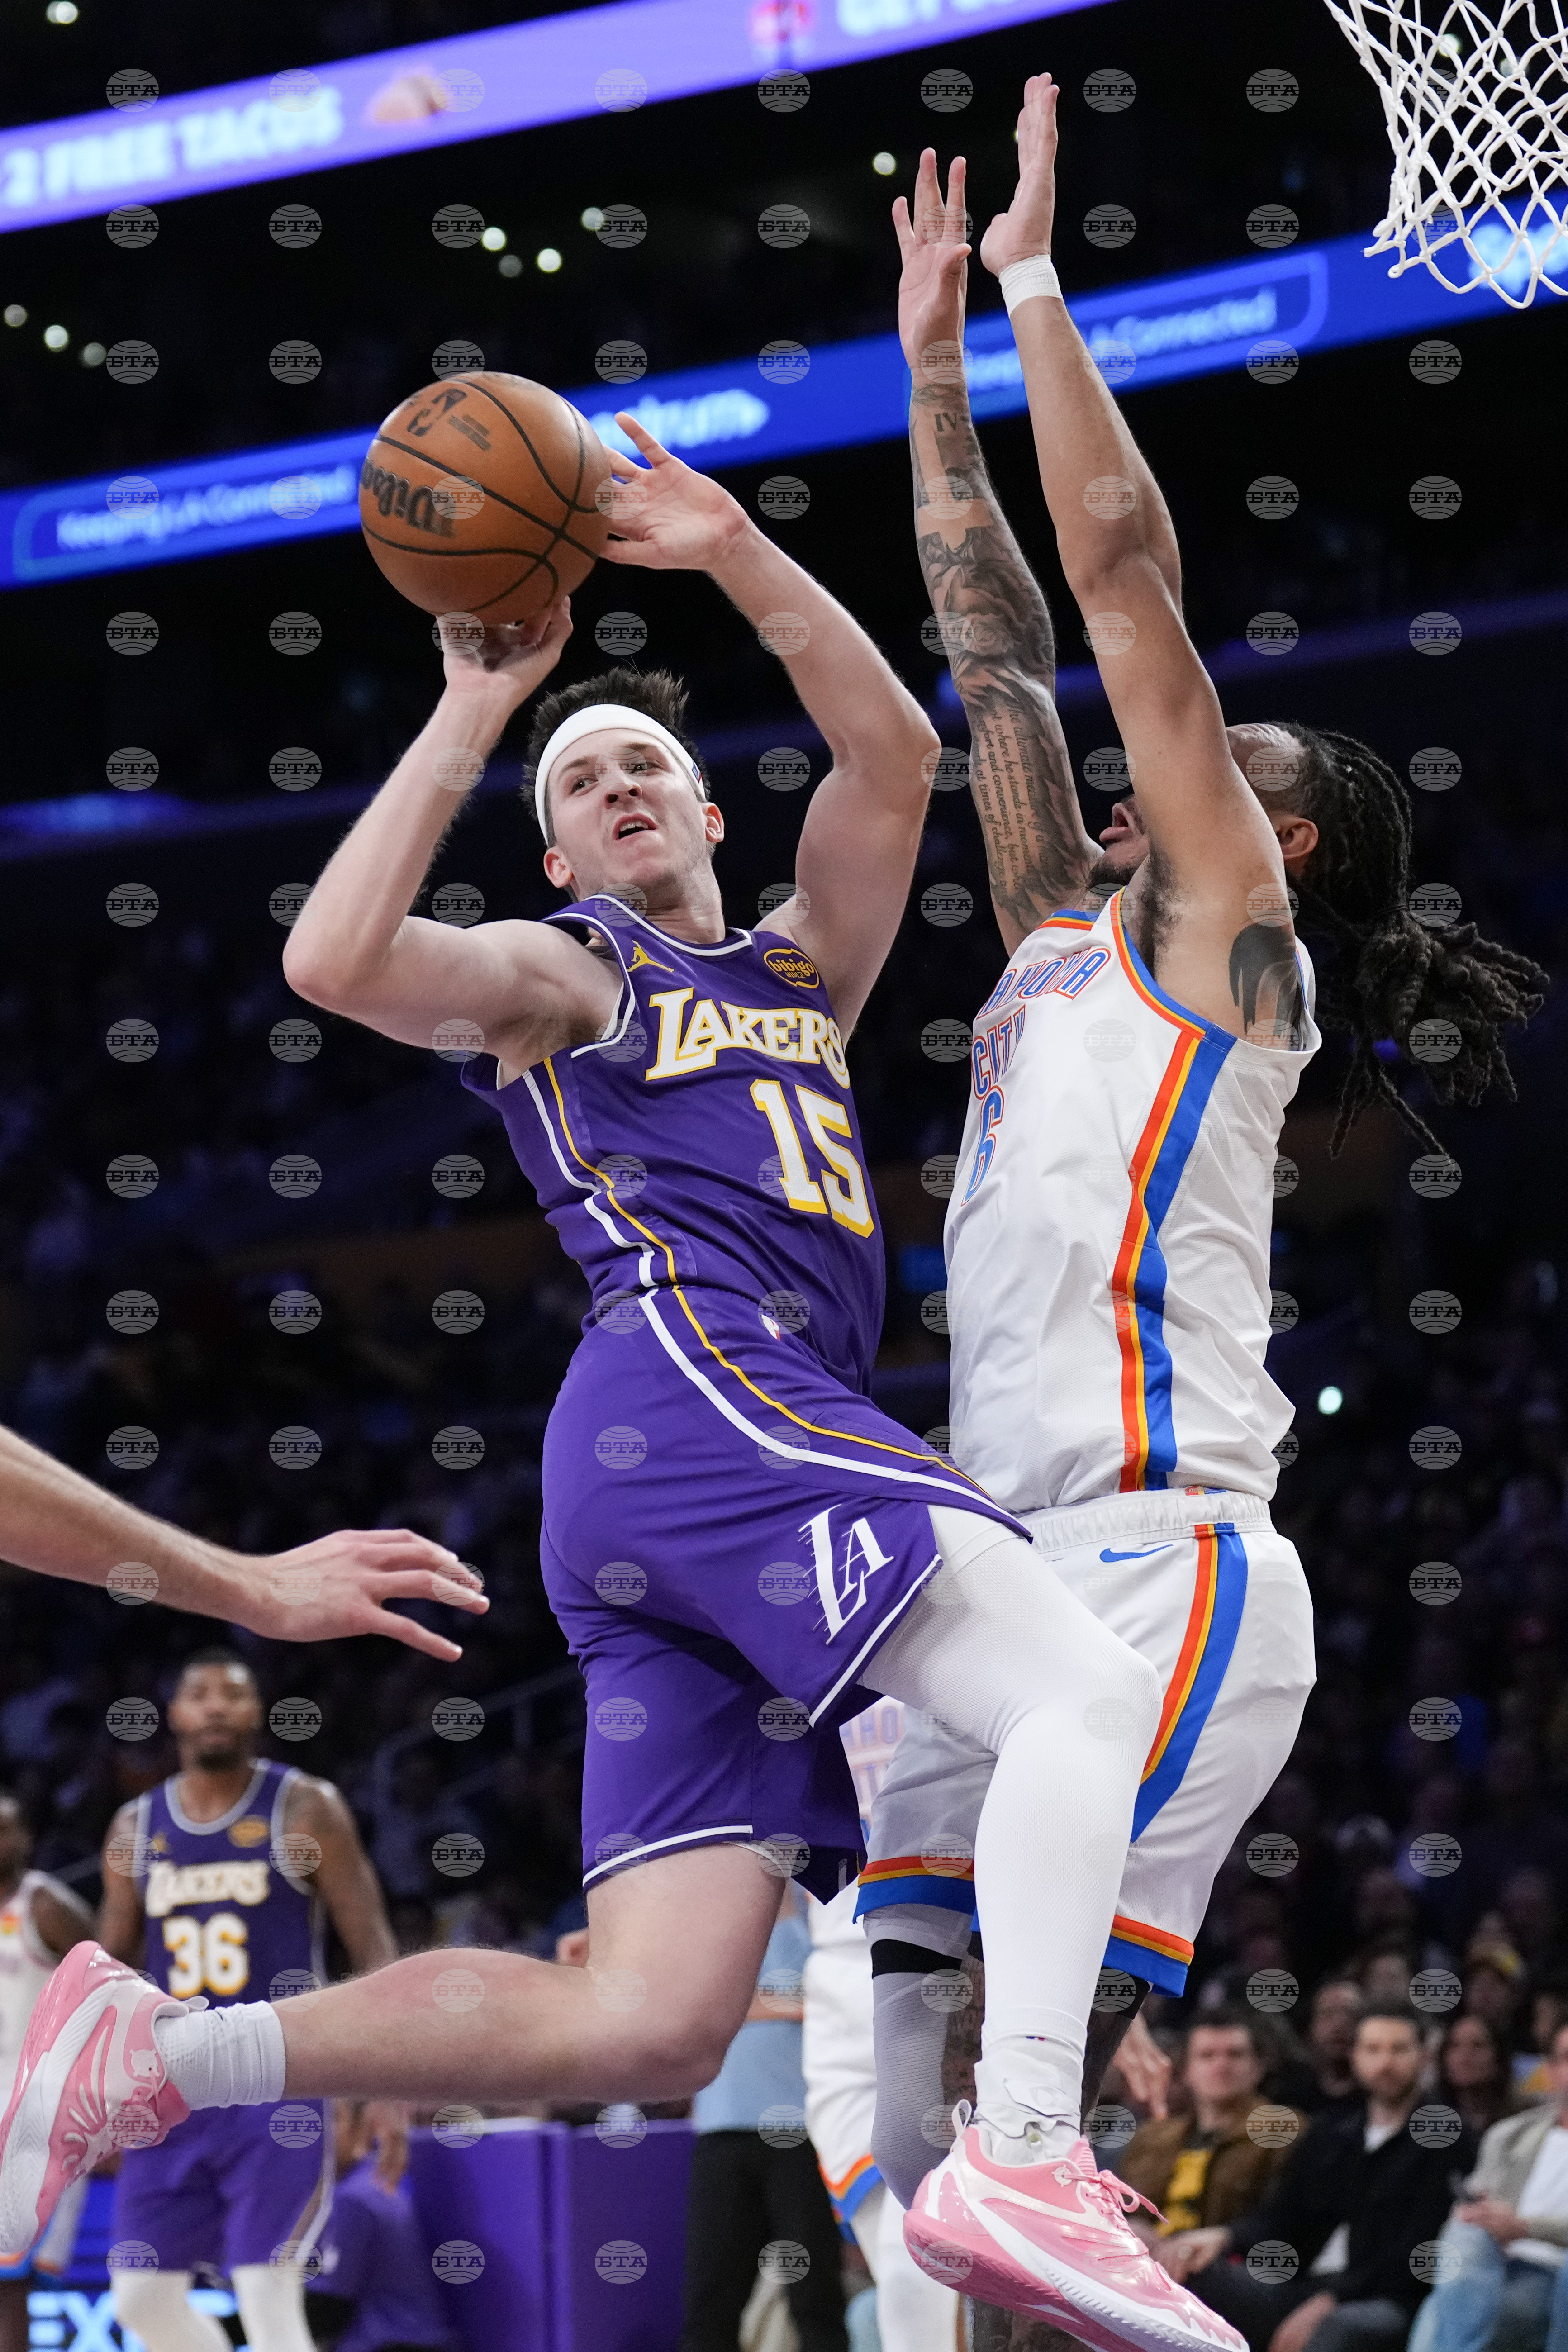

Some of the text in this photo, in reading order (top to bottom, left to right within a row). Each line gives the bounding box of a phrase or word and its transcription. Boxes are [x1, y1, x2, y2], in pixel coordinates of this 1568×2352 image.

[994, 724, 1012, 757] where
[976, 770, 987, 782] at
[988, 751, 1004, 772] and
[1004, 760, 1018, 773] he
[979, 784, 993, 811] times
[1007, 775, 1027, 810] stands
[984, 814, 1002, 826] of
[768, 958, 814, 977] bibigo
[646, 987, 851, 1089] LAKERS
[749, 1079, 875, 1239] 15
[960, 1085, 1005, 1207] 6
[162, 1911, 250, 2000] 36
